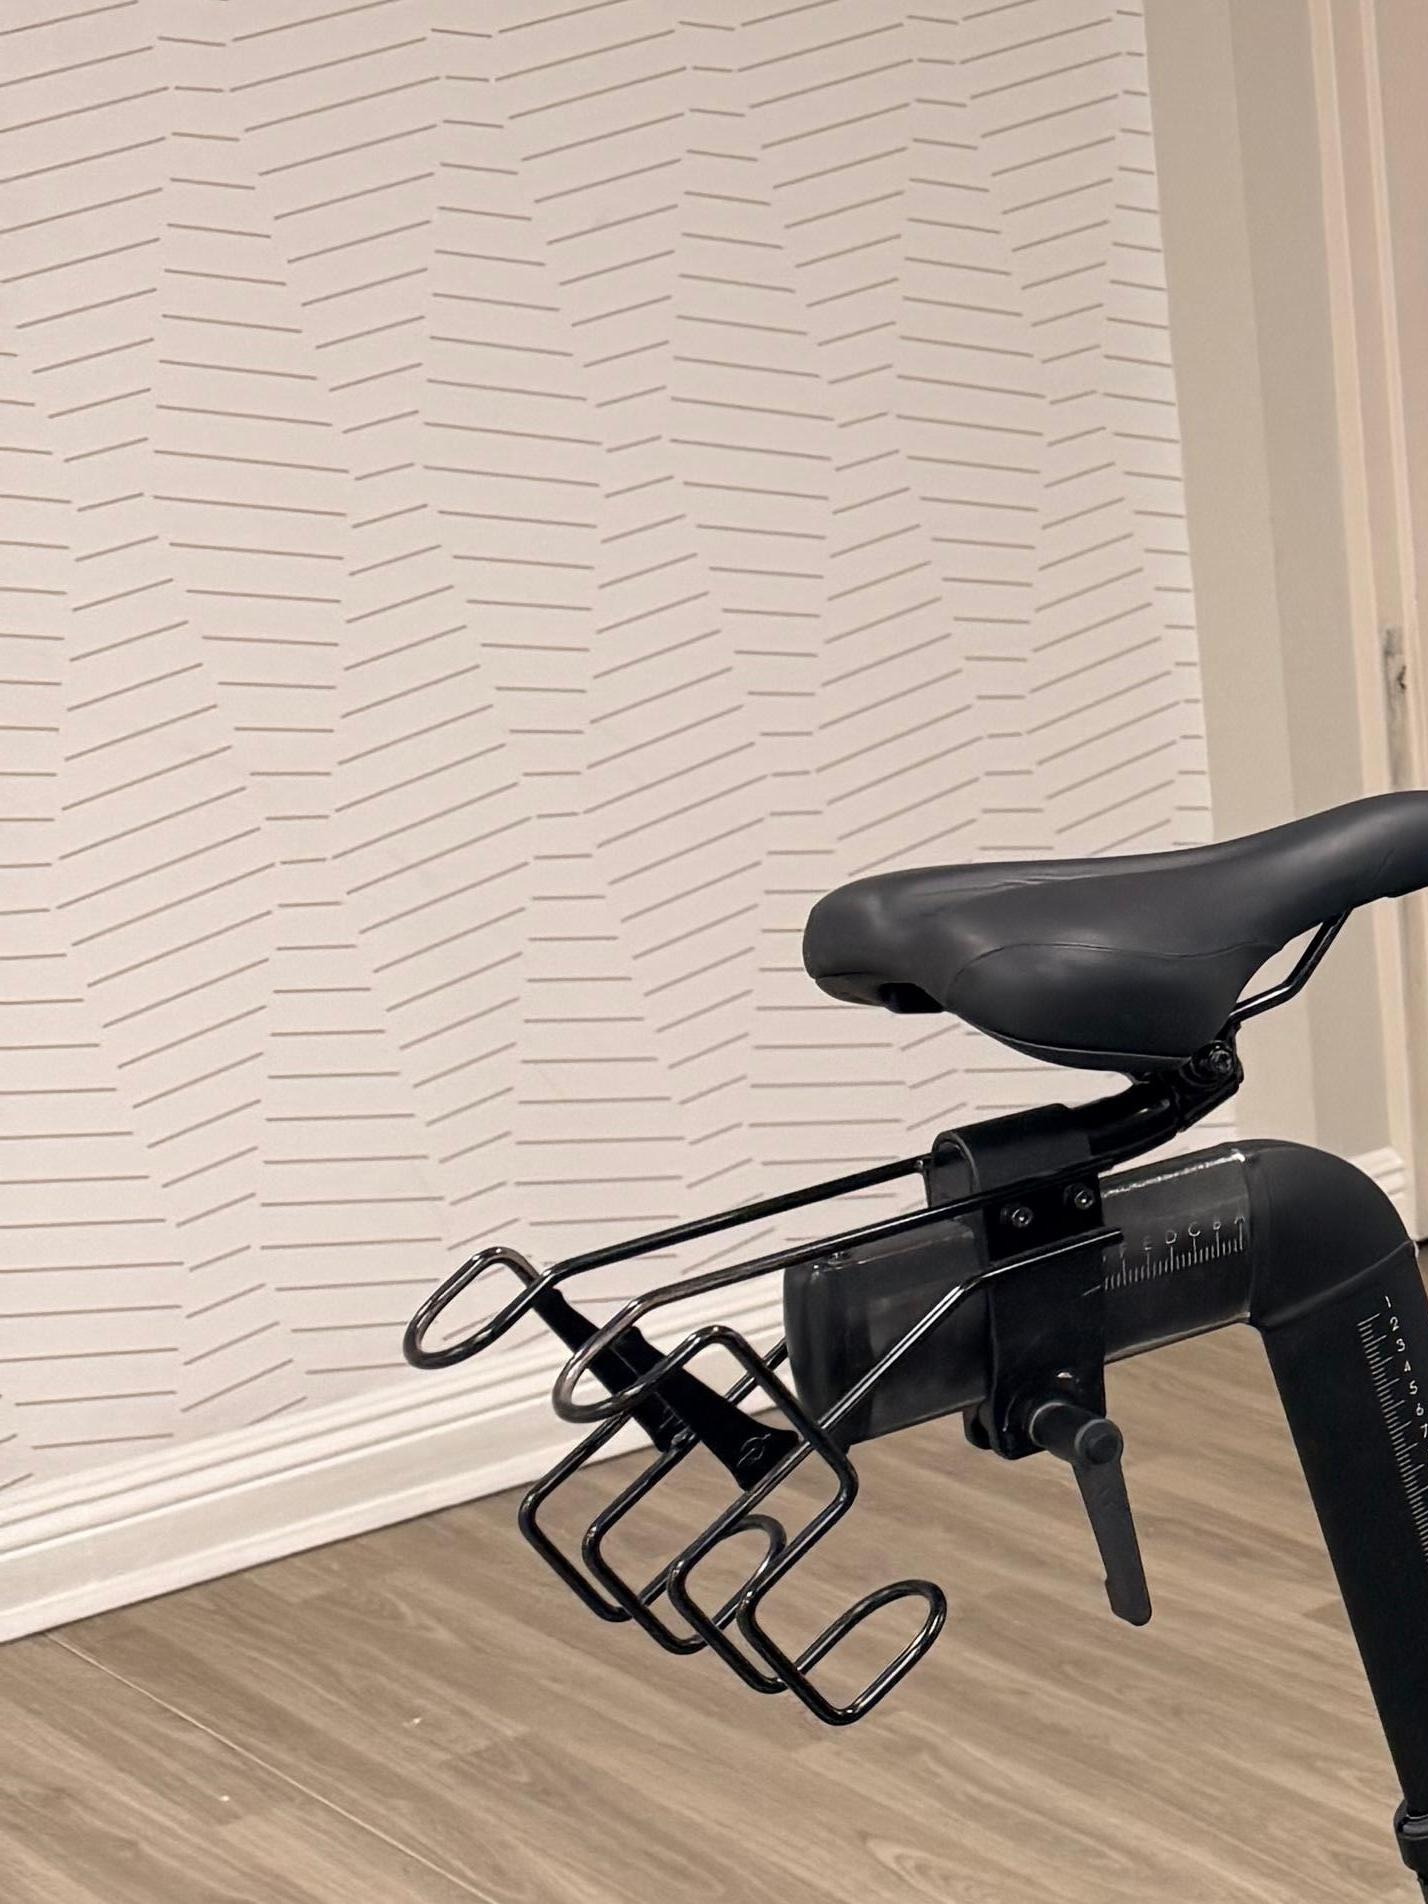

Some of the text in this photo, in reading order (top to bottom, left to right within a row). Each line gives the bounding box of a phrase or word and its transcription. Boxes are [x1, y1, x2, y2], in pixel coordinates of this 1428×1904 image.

[1165, 1230, 1178, 1244] D
[1187, 1221, 1201, 1237] C
[1389, 1316, 1400, 1331] 2
[1396, 1338, 1406, 1352] 3
[1404, 1360, 1412, 1372] 4
[1409, 1380, 1418, 1395] 5
[1416, 1402, 1424, 1416] 6
[1420, 1423, 1428, 1438] 7
